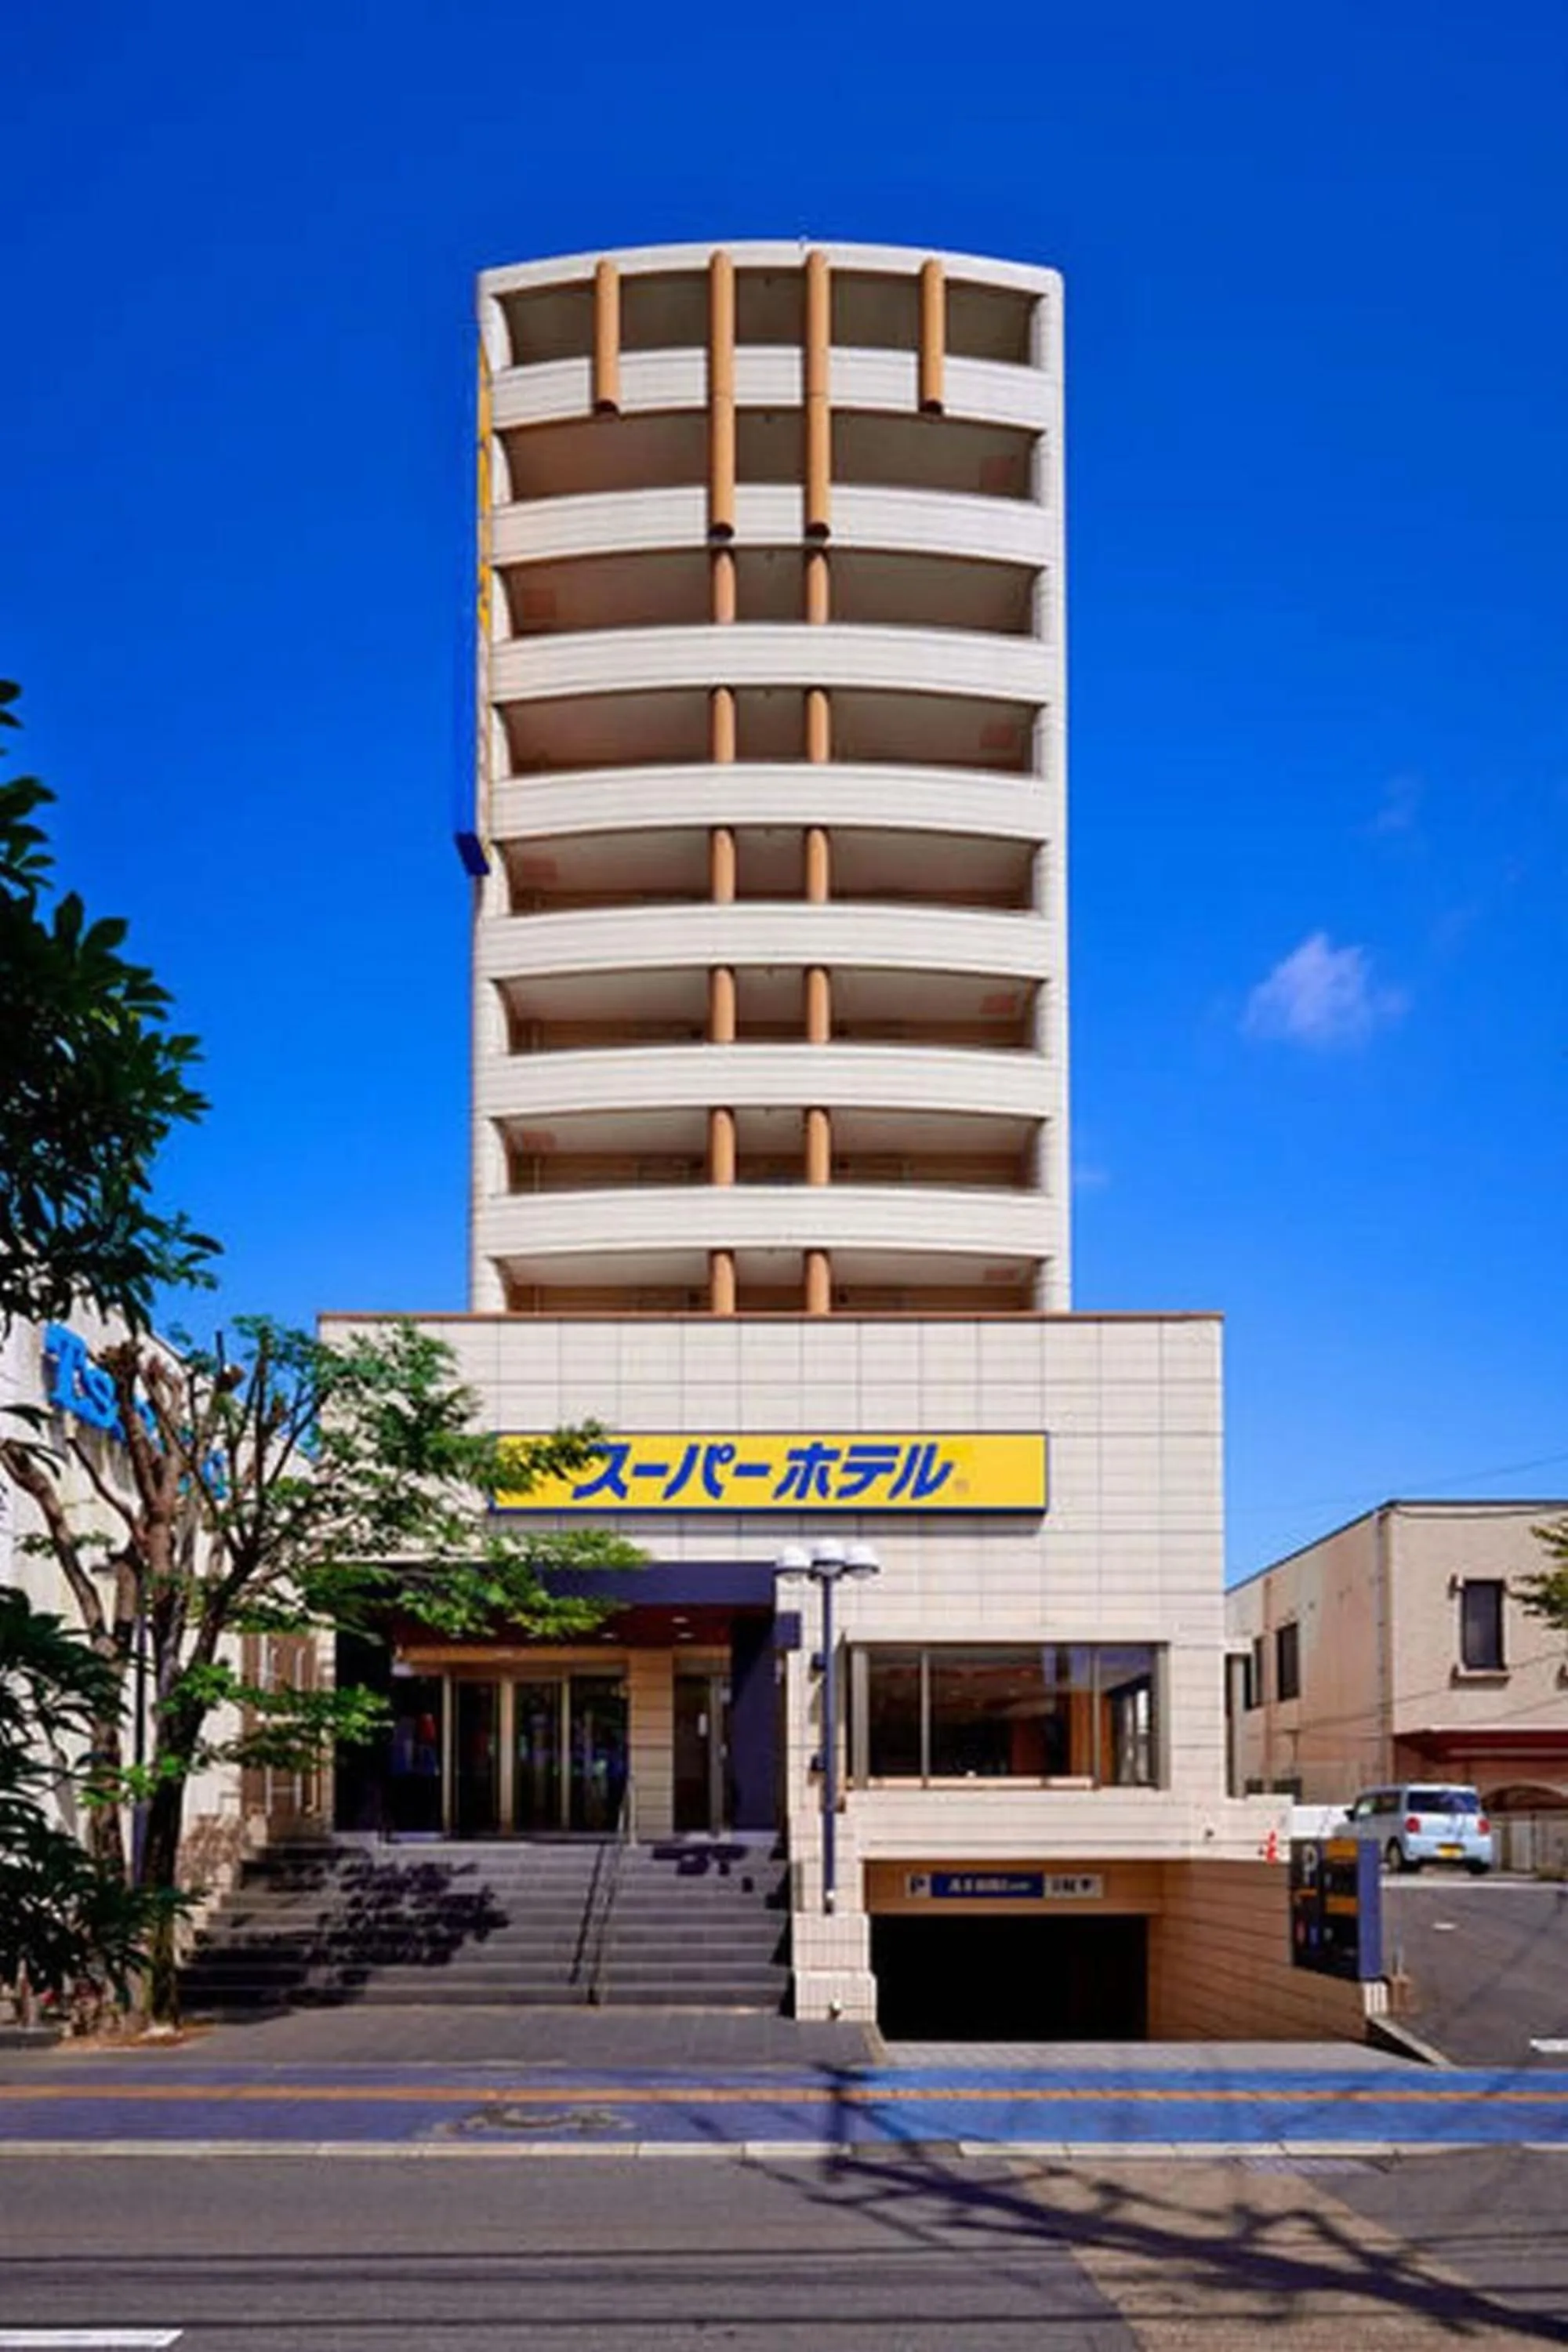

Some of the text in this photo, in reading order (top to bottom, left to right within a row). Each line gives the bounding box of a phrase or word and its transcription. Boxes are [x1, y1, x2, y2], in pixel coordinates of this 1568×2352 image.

[572, 1442, 953, 1500] スーパーホテル
